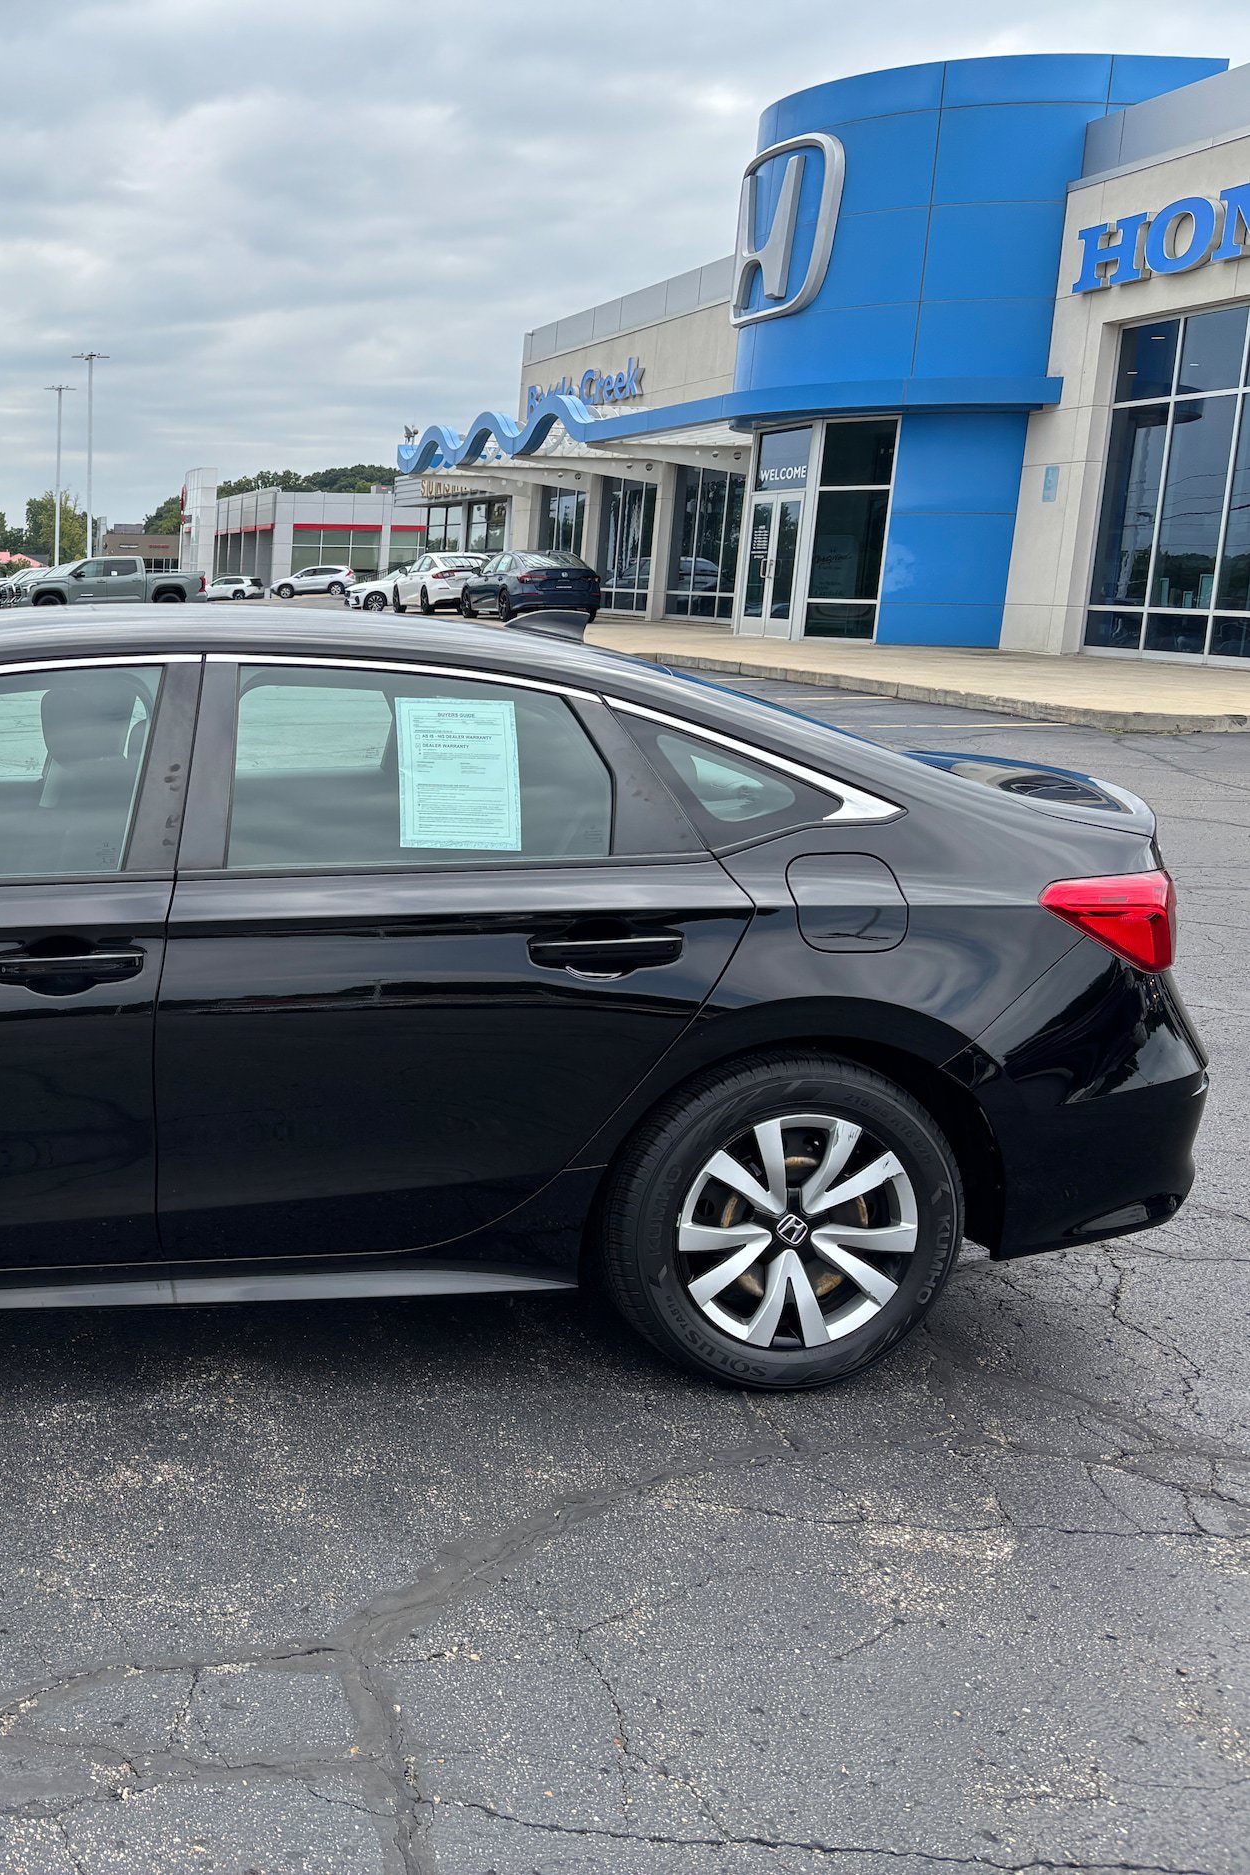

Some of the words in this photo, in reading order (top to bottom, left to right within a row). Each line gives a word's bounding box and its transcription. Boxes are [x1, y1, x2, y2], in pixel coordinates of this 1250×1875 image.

[580, 356, 645, 405] Creek
[760, 465, 807, 482] WELCOME
[917, 1214, 950, 1304] KUMHO
[685, 1330, 768, 1377] SOLUS
